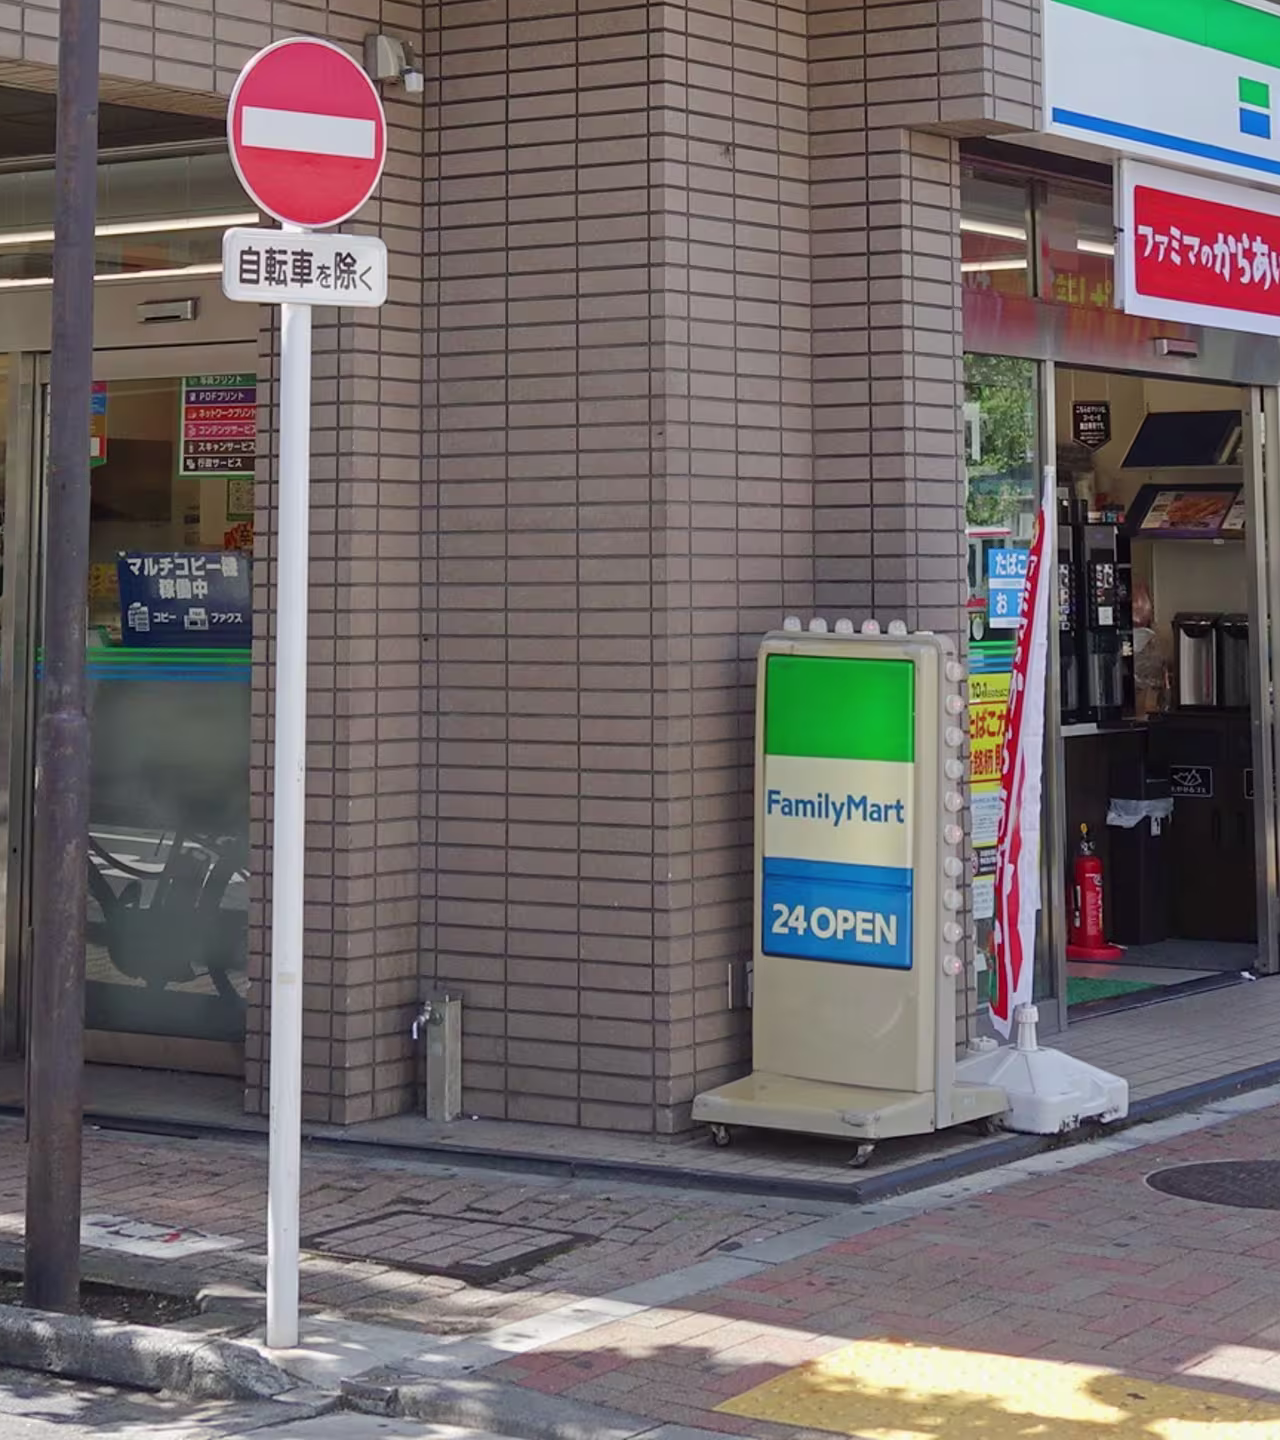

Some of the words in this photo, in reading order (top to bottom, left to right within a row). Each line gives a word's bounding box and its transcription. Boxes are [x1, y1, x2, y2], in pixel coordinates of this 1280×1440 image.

[239, 246, 373, 291] 自転車を除く
[200, 391, 244, 401] PDFプリント
[199, 408, 256, 418] ネットワークプリント
[199, 424, 256, 435] コンテンツサービス
[198, 441, 256, 452] スキャンサービス
[197, 458, 242, 468] 行政サービス
[127, 555, 239, 578] マルチコピー機
[995, 553, 1028, 576] たばこ
[158, 578, 209, 600] 稼働中
[153, 612, 177, 623] コピー
[211, 611, 244, 623] ファクス
[969, 743, 1003, 775] 銘柄
[767, 789, 905, 828] FamilyMart
[772, 903, 807, 937] 24
[810, 907, 897, 947] OPEN
